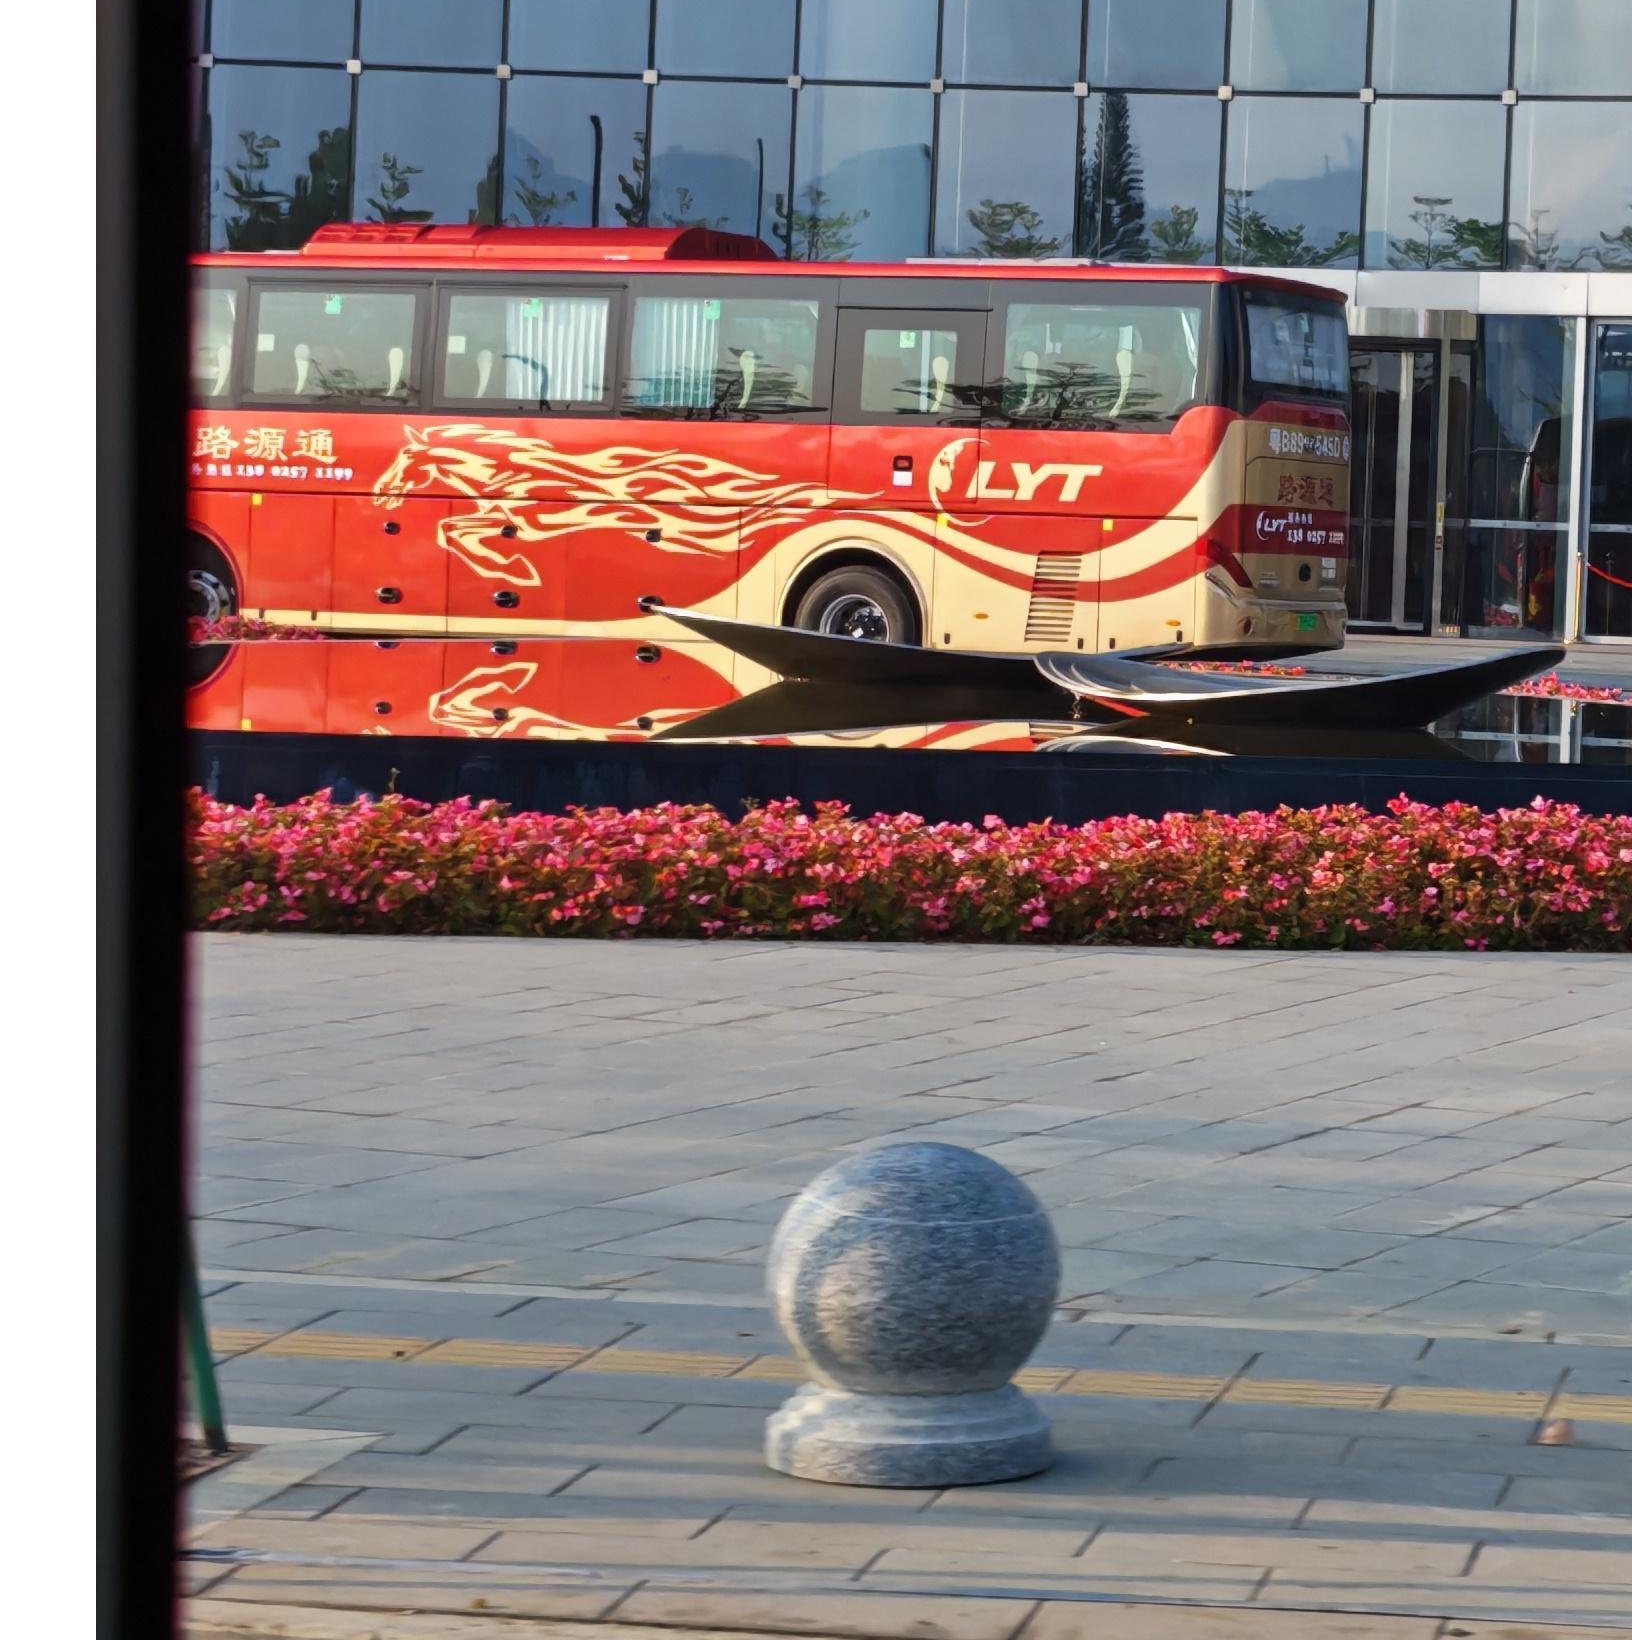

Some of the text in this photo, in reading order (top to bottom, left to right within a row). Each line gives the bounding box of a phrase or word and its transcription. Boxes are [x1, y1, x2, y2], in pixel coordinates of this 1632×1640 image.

[192, 425, 338, 465] 路源通
[965, 460, 1104, 502] LYT
